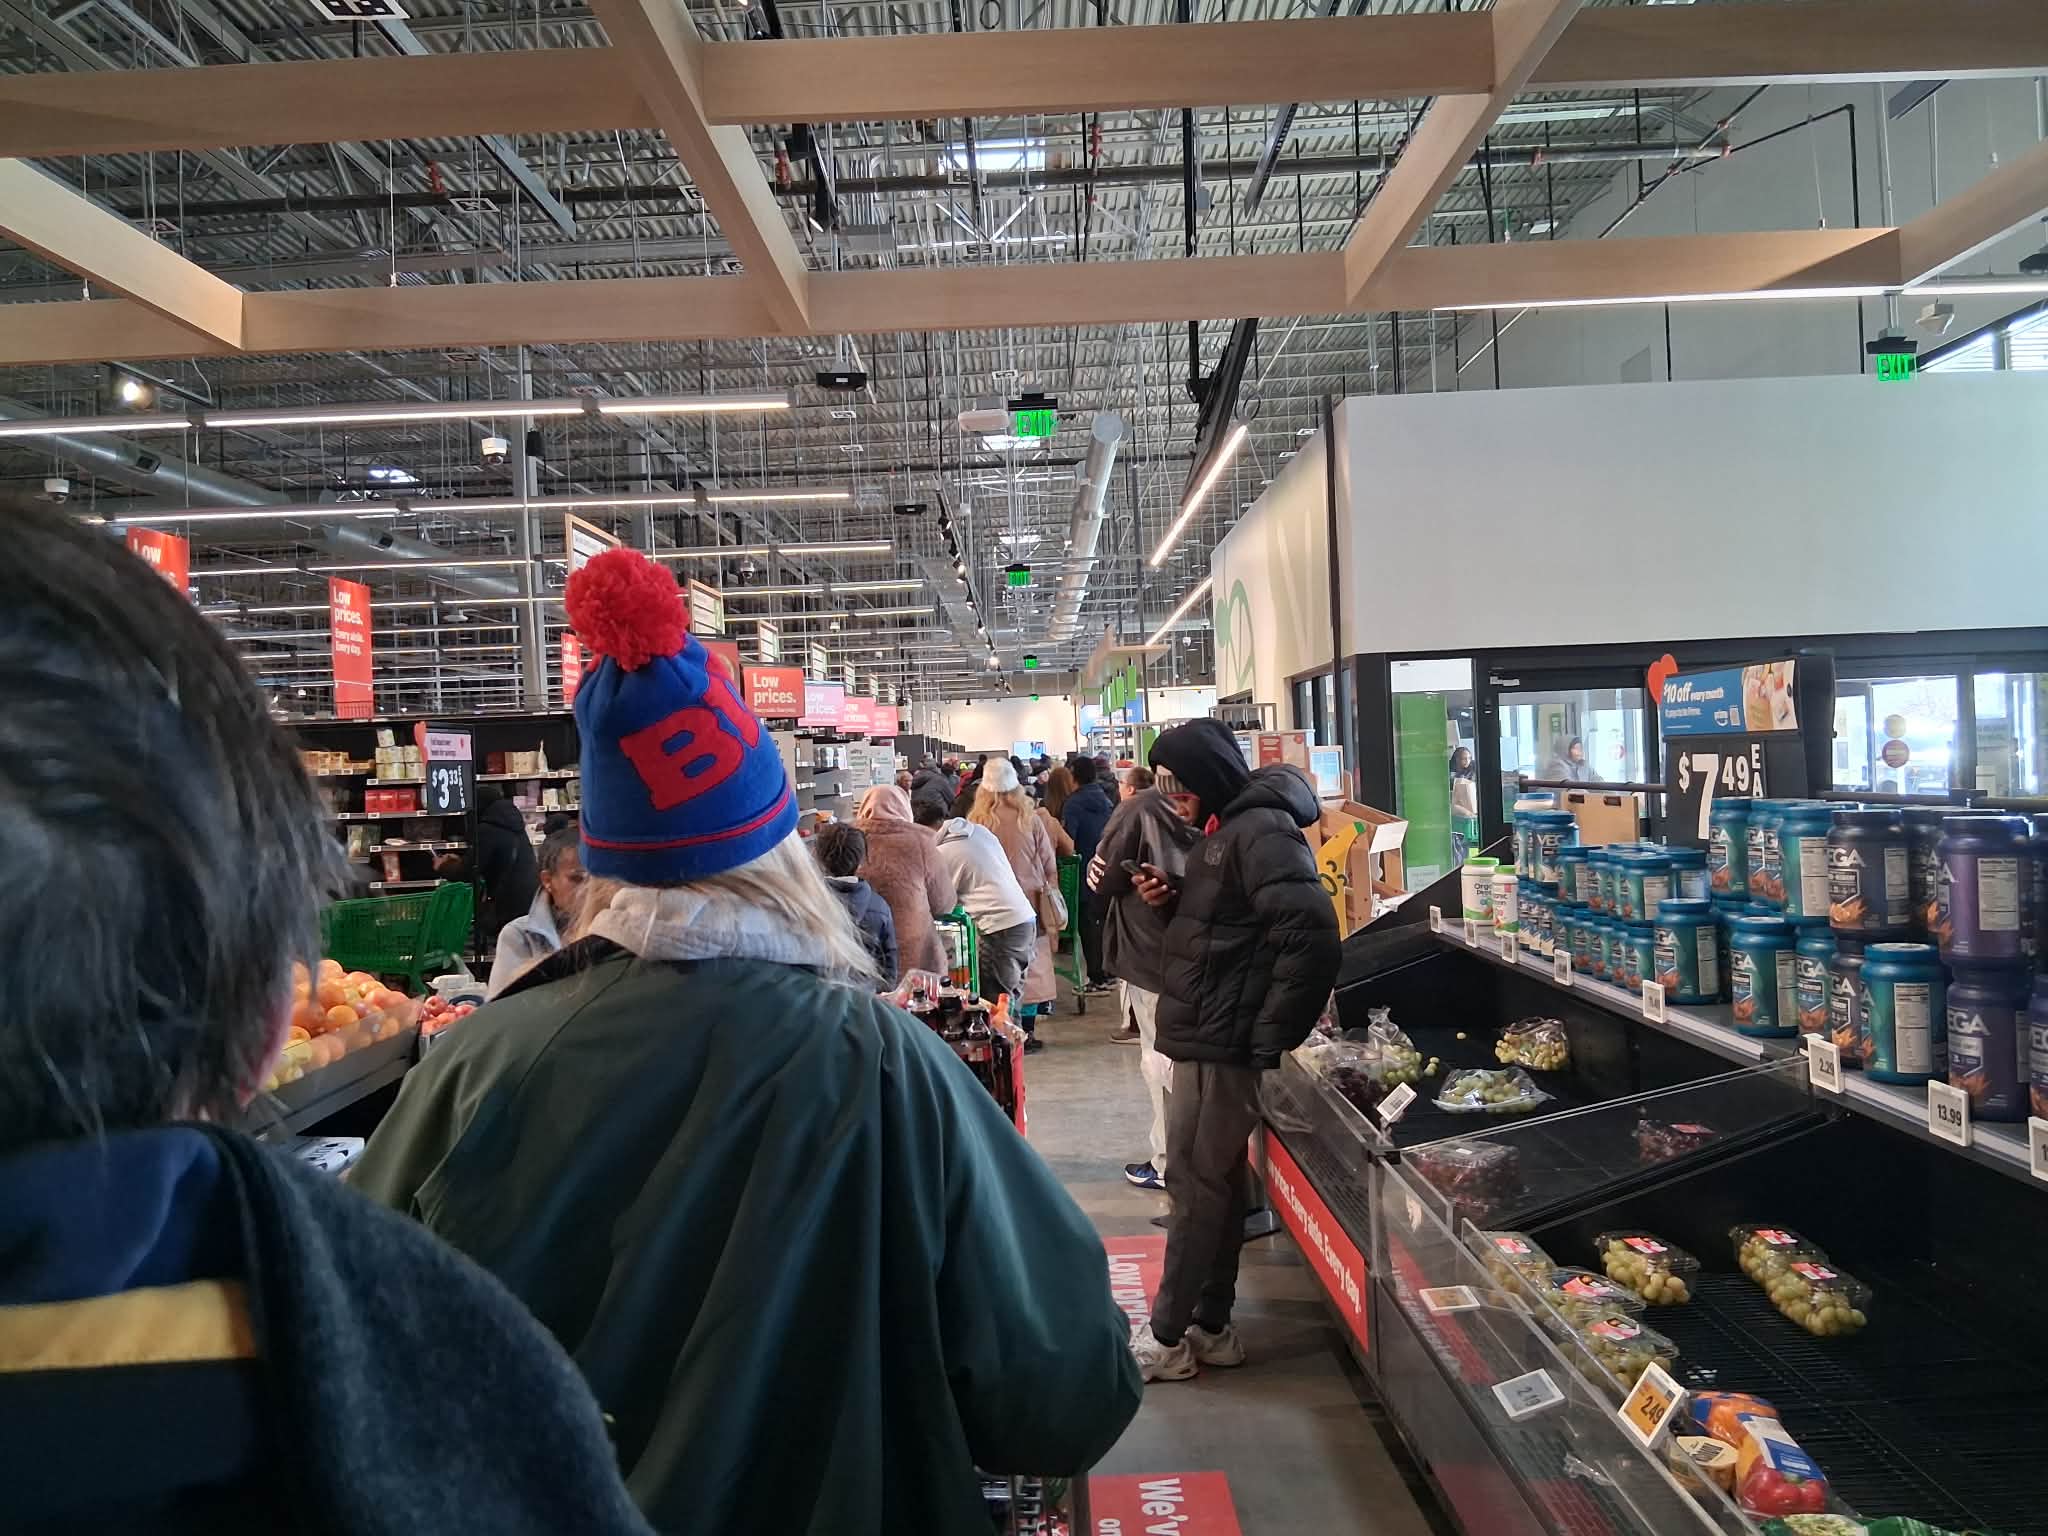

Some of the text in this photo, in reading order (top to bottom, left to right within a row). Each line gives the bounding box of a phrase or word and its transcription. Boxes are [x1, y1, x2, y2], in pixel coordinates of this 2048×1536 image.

[1877, 353, 1909, 381] EXIT
[1016, 410, 1052, 437] EXIT
[333, 585, 351, 605] Low
[335, 606, 363, 626] prices.
[753, 672, 779, 688] Low
[753, 688, 797, 707] prices.
[1677, 682, 1693, 702] off
[1937, 1104, 1962, 1127] 13.99
[1290, 1185, 1308, 1234] Every
[1324, 1233, 1345, 1291] Every
[1345, 1267, 1362, 1314] day.
[1107, 1252, 1148, 1286] Low
